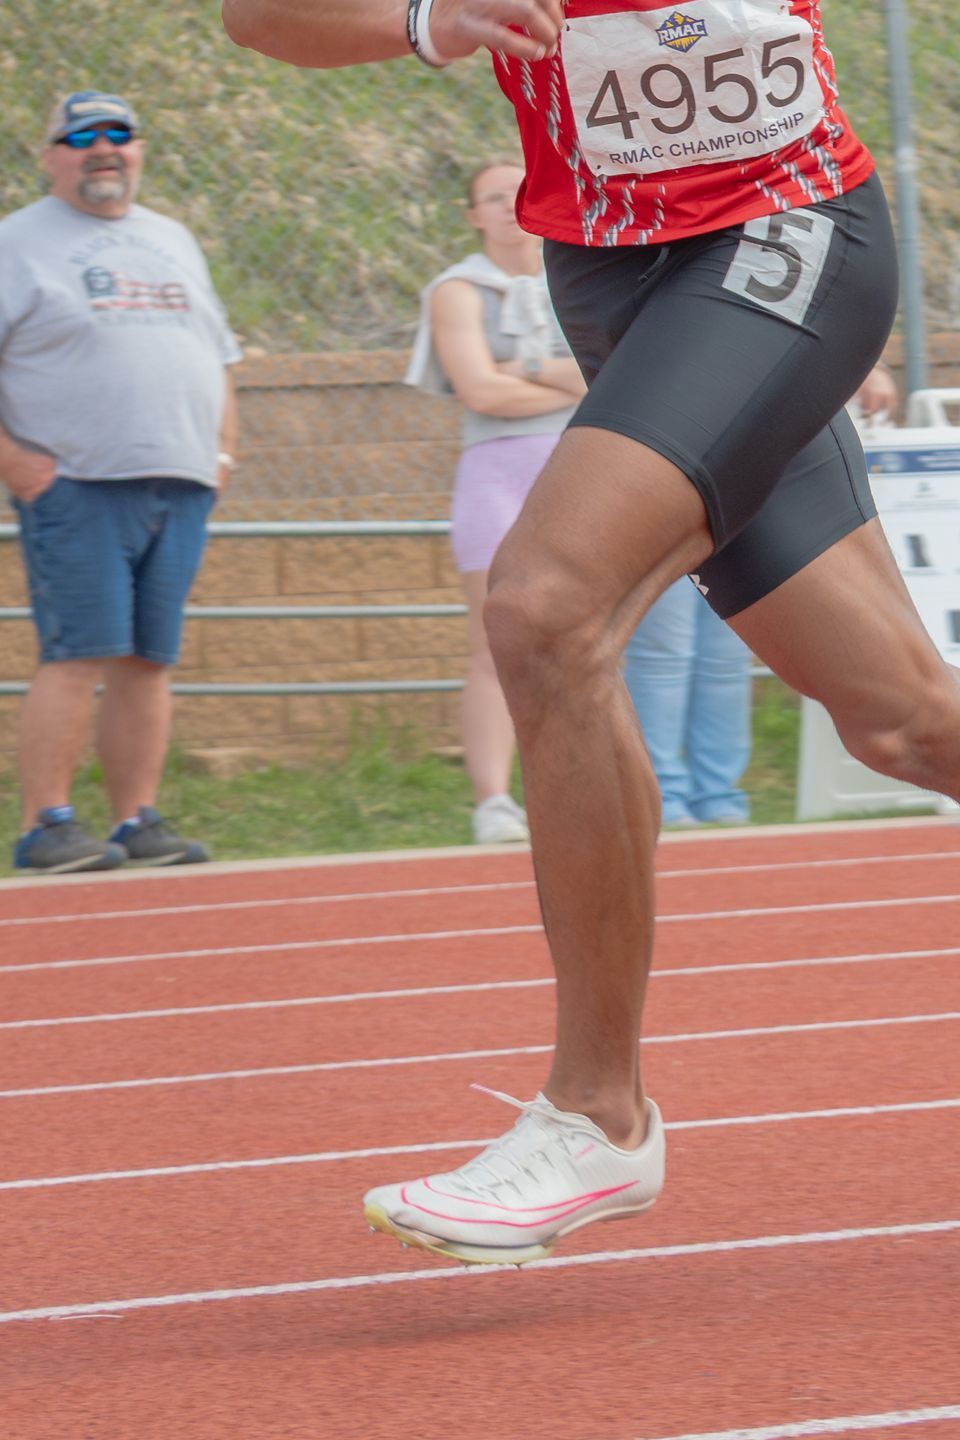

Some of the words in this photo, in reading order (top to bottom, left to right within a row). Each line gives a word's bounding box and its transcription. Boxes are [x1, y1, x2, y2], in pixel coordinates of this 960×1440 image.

[657, 21, 706, 44] RMAC
[586, 33, 804, 139] 4955
[609, 143, 665, 165] RMAC
[669, 112, 804, 158] CHAMPIONSHIP
[744, 212, 814, 303] 5
